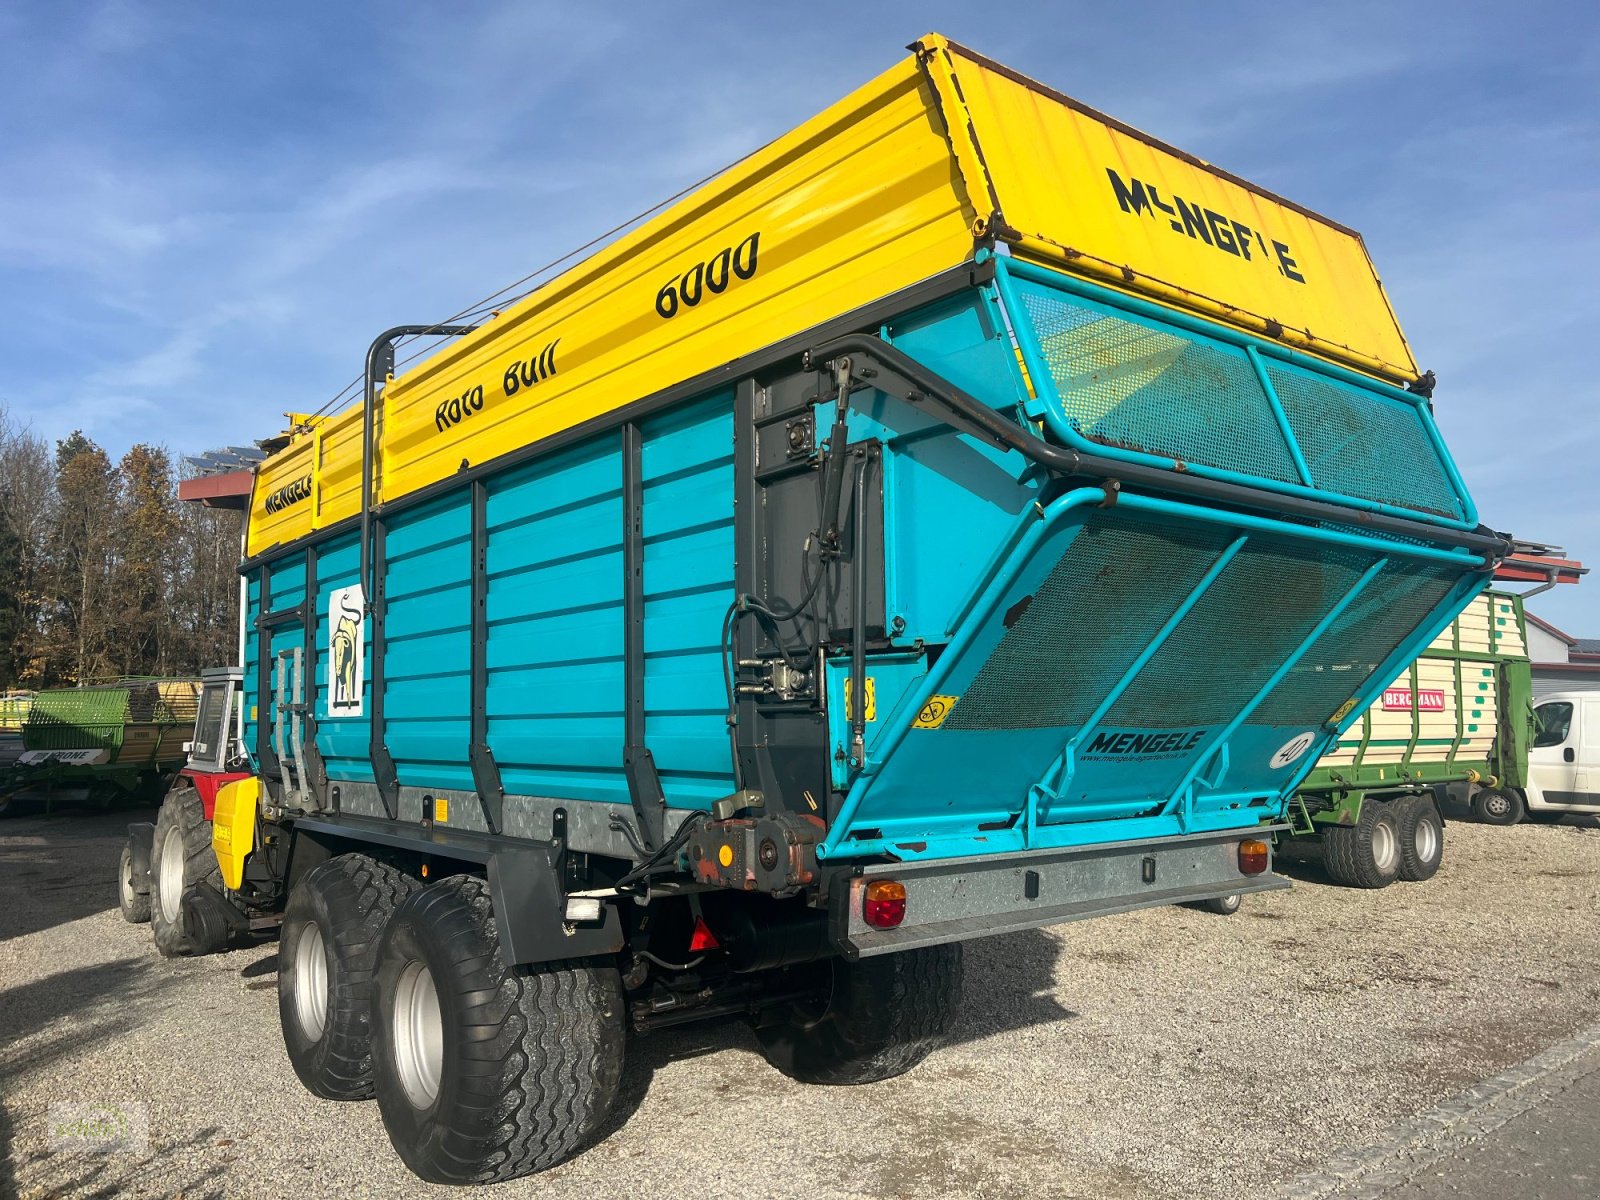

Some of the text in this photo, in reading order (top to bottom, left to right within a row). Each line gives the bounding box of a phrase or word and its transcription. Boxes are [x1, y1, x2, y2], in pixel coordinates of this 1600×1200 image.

[435, 231, 761, 433] Roto Bull 6000
[1085, 731, 1208, 754] MENGELE
[1278, 738, 1309, 763] 40
